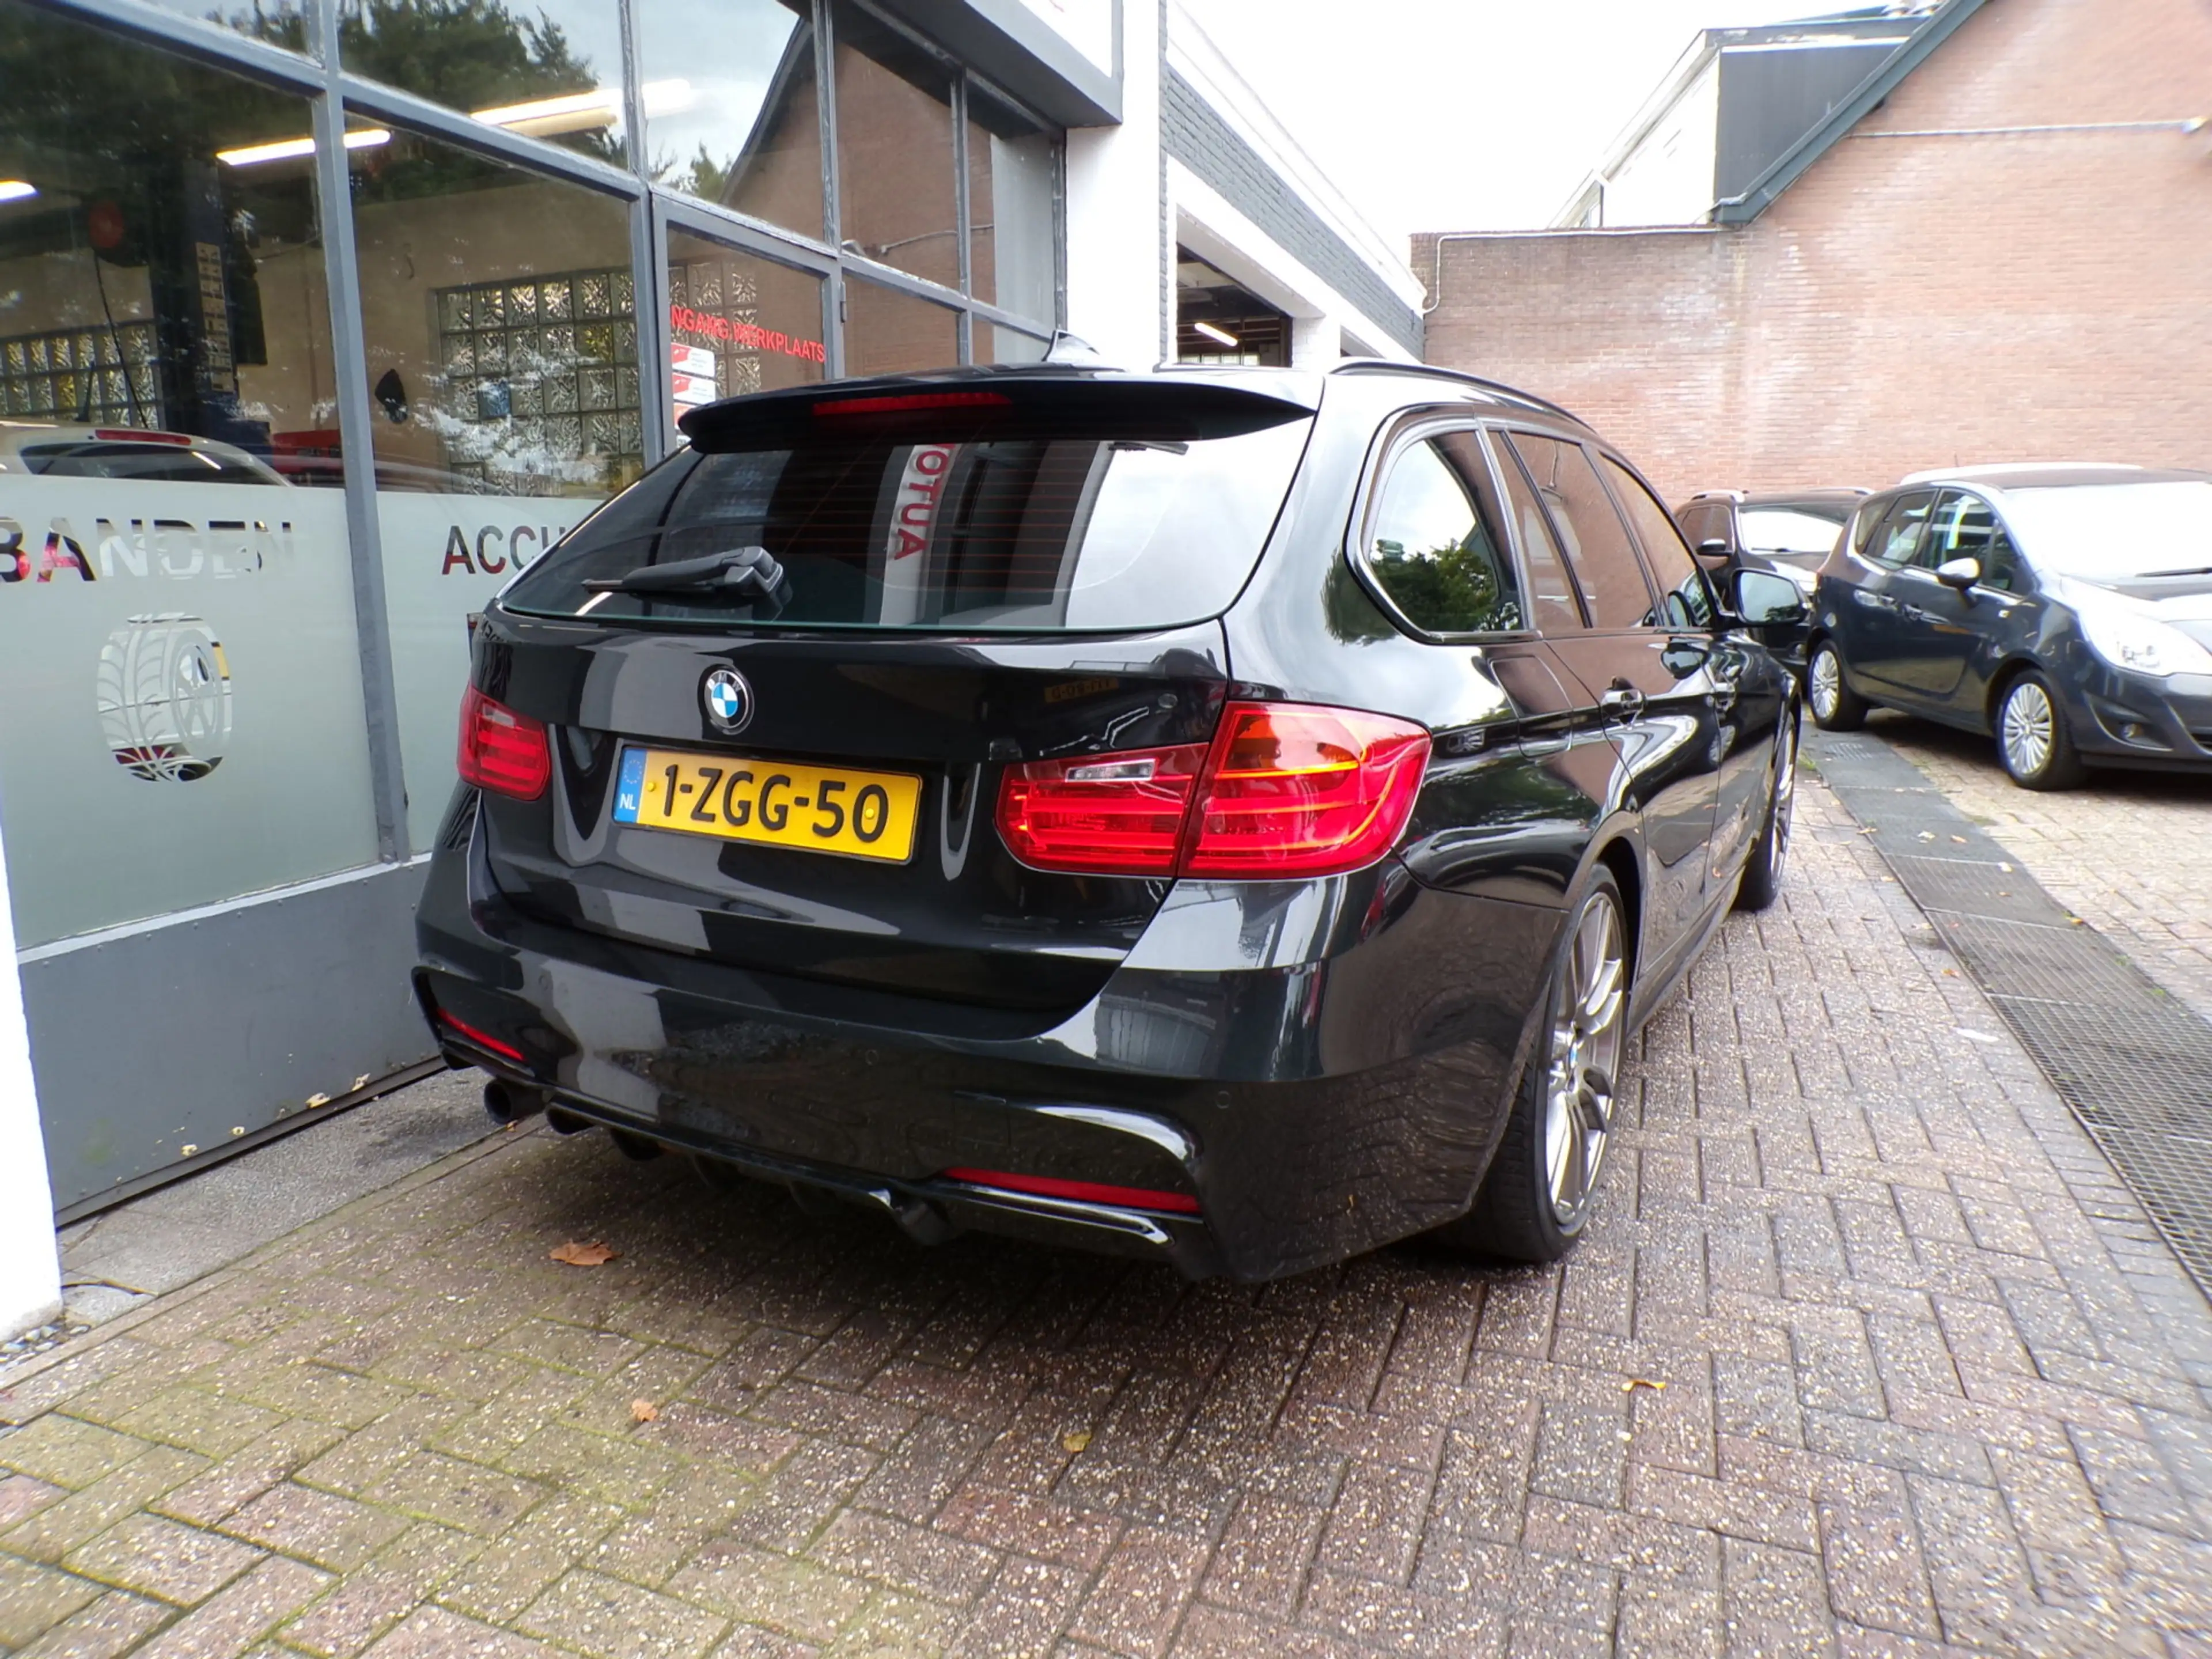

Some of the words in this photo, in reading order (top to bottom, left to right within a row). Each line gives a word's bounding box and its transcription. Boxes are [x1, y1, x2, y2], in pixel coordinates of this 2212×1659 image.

[671, 305, 728, 340] NGANG
[733, 323, 825, 362] WERKPLAATS
[706, 672, 743, 692] BMW
[619, 793, 637, 810] NL
[662, 763, 889, 843] 1-ZGG-50
